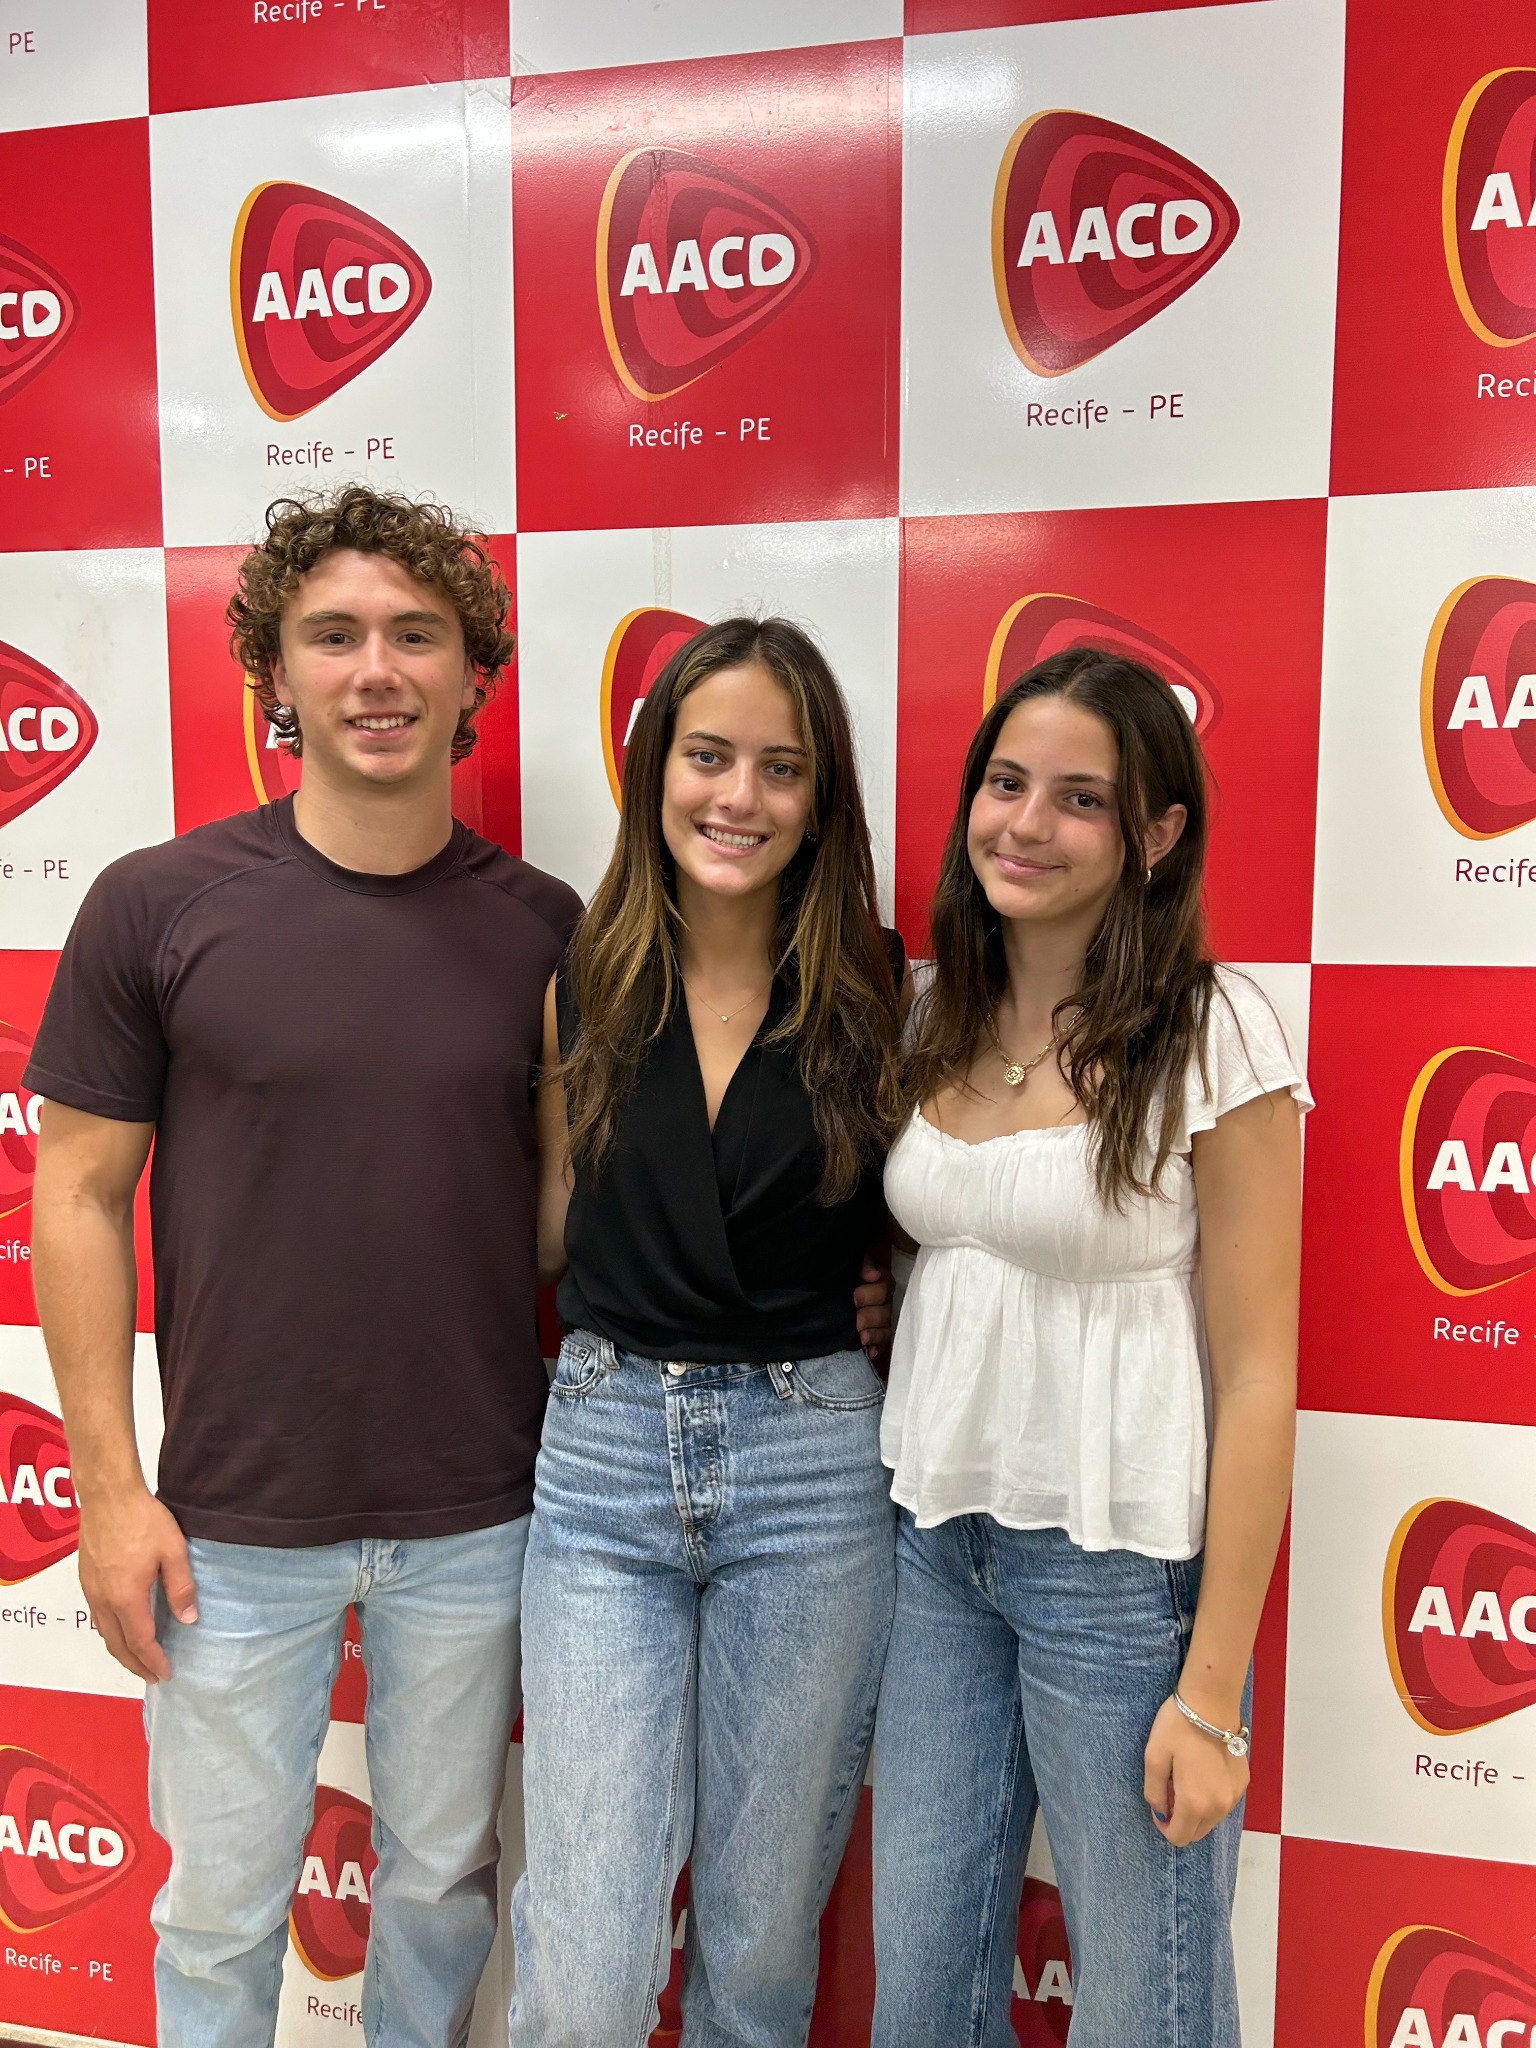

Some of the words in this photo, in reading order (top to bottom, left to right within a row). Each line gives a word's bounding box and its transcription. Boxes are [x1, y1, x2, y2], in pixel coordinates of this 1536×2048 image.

[254, 0, 323, 24] Recife
[9, 31, 35, 54] PE
[1016, 199, 1214, 268] AACD
[620, 233, 796, 297] AACD
[252, 262, 410, 322] AACD
[0, 289, 61, 340] CD
[1027, 400, 1109, 429] Recife
[1150, 394, 1184, 420] PE
[266, 441, 333, 468] Recife
[367, 437, 395, 460] PE
[628, 420, 703, 450] Recife
[739, 418, 771, 442] PE
[25, 456, 51, 478] PE
[1446, 673, 1536, 730] AA
[0, 706, 79, 752] CD
[44, 859, 69, 879] PE
[1426, 1139, 1536, 1193] AA
[1433, 1317, 1520, 1349] Recife
[0, 1464, 81, 1509] AC
[1, 1606, 47, 1628] ecife
[1407, 1585, 1536, 1645] AAC
[1415, 1754, 1499, 1787] Recife
[0, 1815, 124, 1867] AACD
[297, 1856, 371, 1904] AA
[5, 1947, 62, 1975] Recife
[89, 1961, 113, 1982] PE
[1389, 2007, 1536, 2048] AAC
